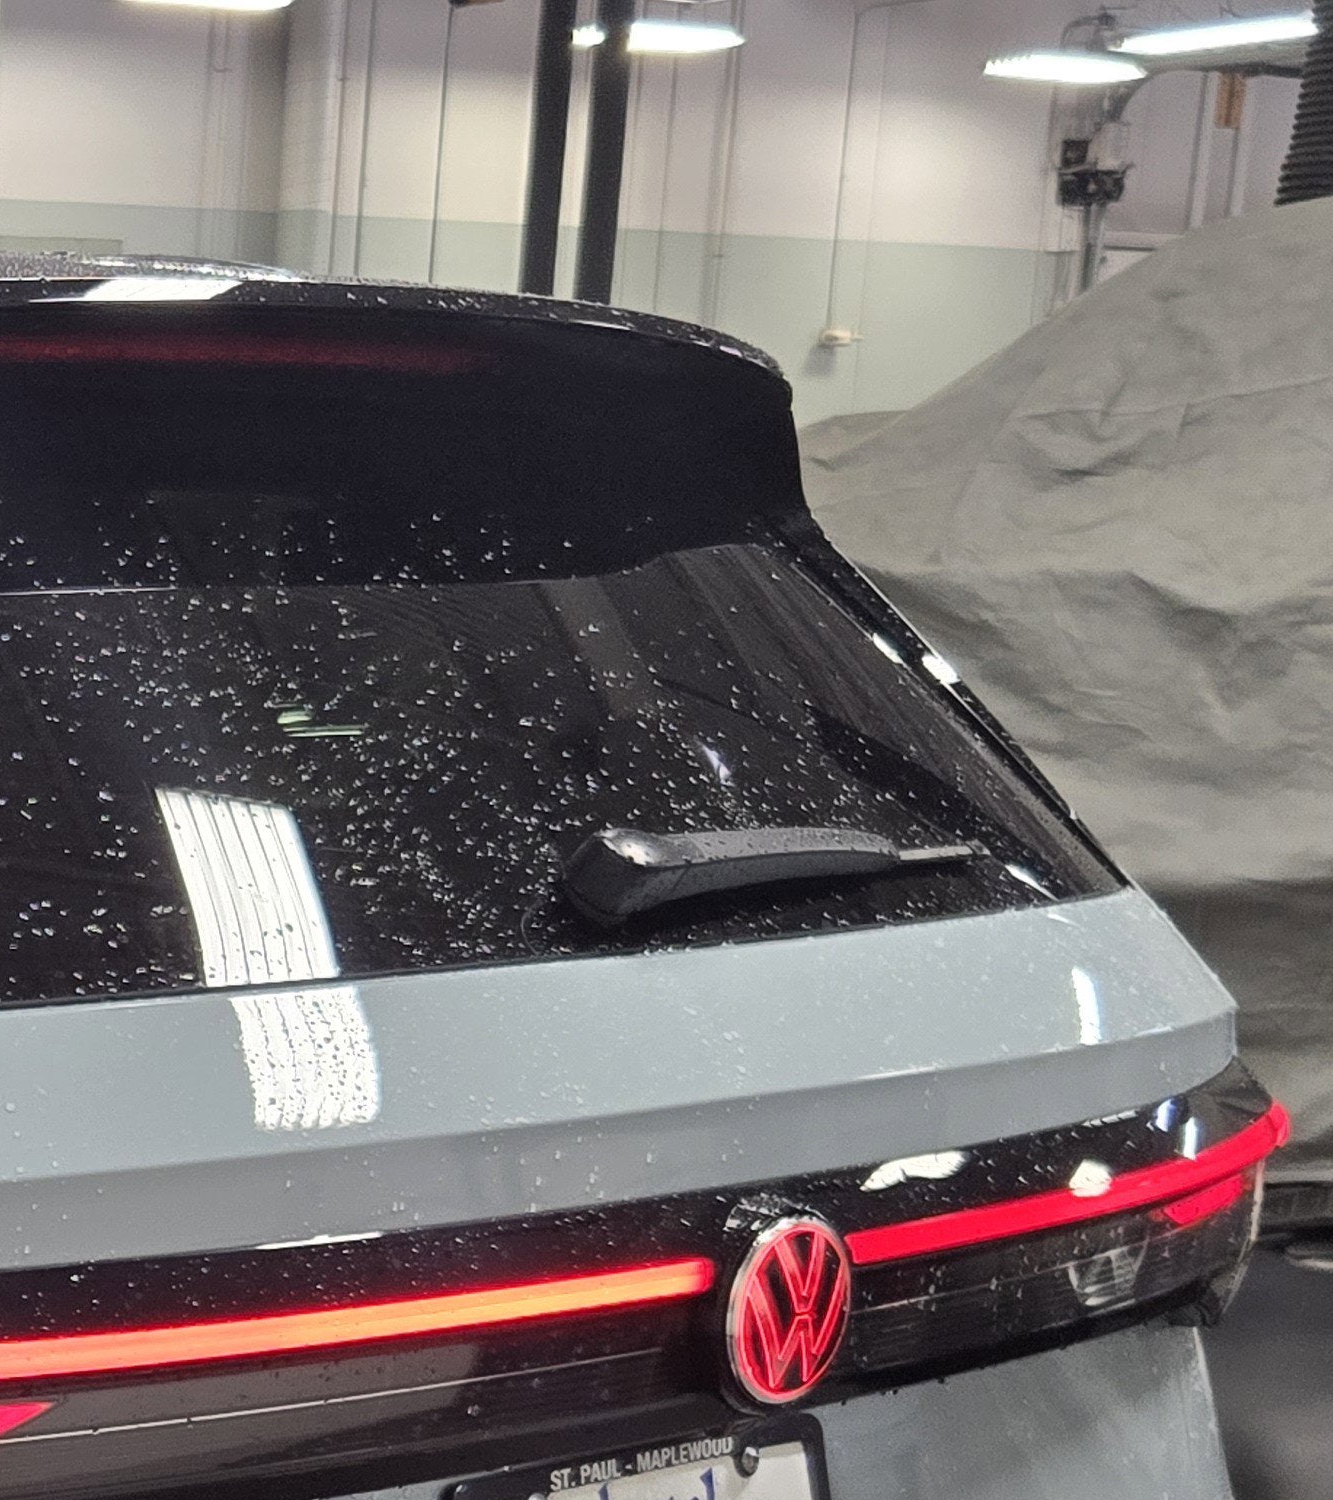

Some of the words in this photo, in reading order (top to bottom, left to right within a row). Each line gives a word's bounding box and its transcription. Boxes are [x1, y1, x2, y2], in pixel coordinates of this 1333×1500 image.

[549, 1468, 576, 1491] ST.
[580, 1458, 622, 1485] PAUL
[636, 1436, 733, 1472] MAPLEWOOD
